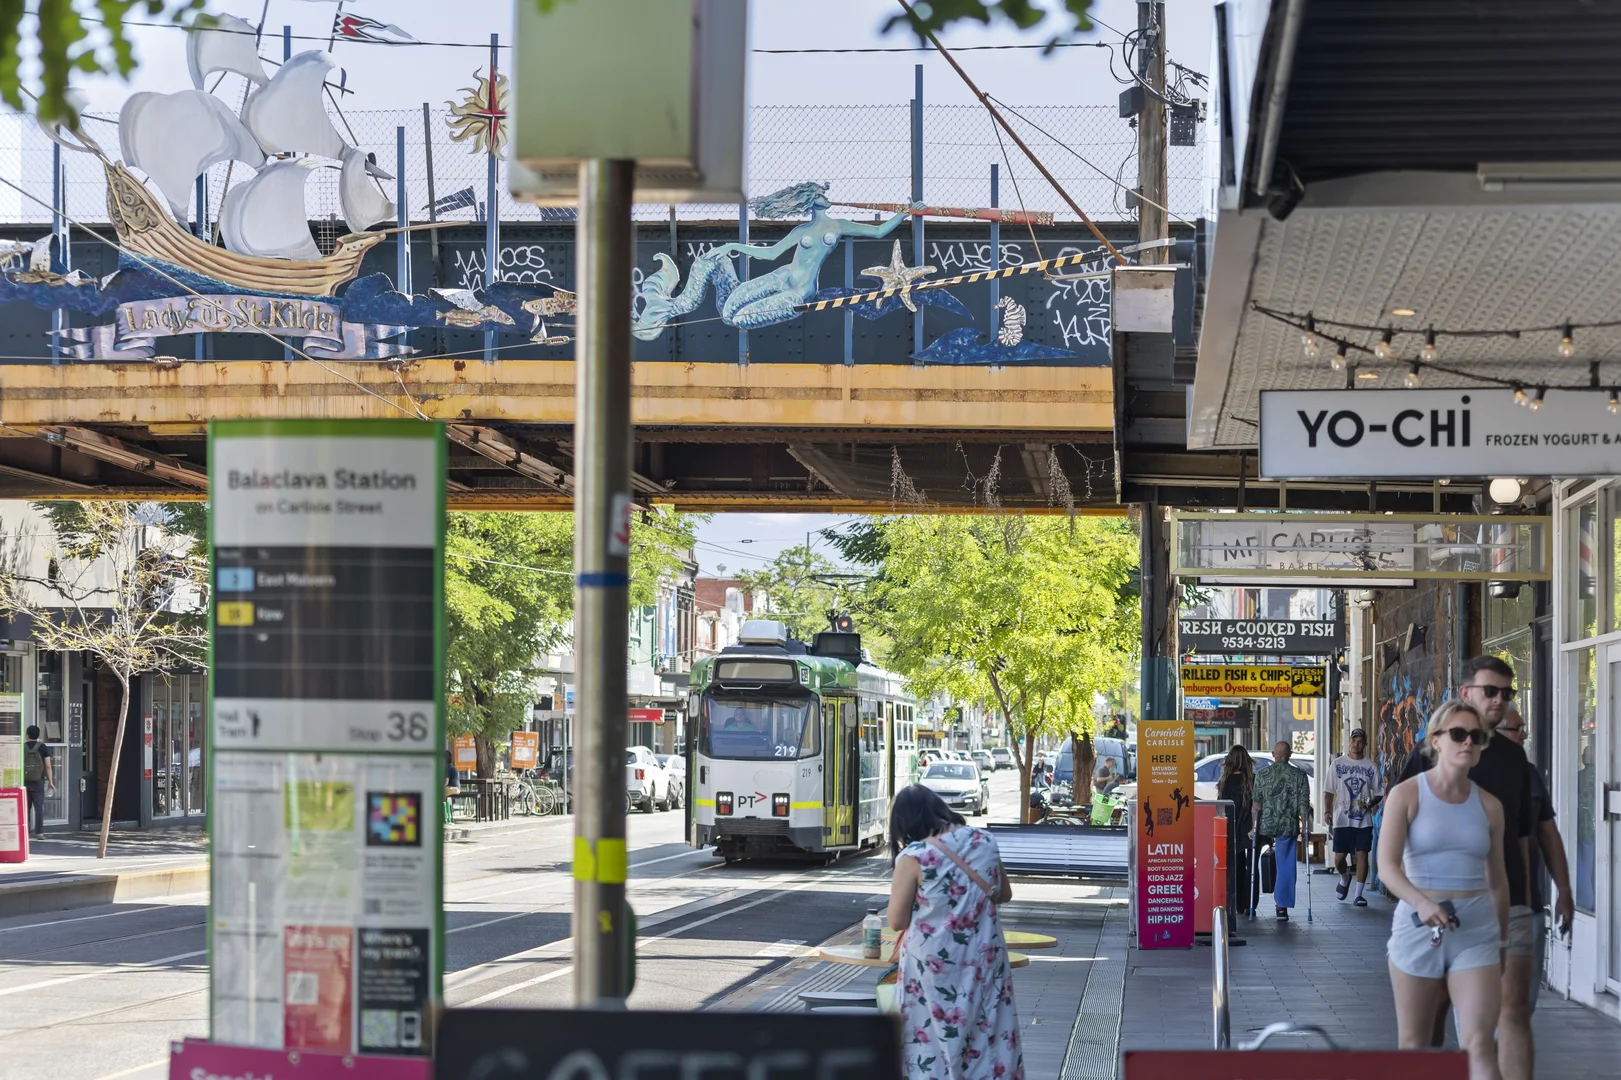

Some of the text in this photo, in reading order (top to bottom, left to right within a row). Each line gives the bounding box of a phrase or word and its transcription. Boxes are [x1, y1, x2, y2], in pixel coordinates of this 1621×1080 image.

[124, 303, 190, 334] Lady
[195, 297, 231, 329] of
[268, 300, 334, 332] Kilda
[1486, 433, 1538, 446] FROZEN
[1543, 433, 1599, 446] YOGURT
[1603, 434, 1611, 444] &
[228, 468, 416, 491] Balaclava Station
[256, 500, 383, 514] on Carlisle Street
[257, 608, 283, 621] Kew
[1180, 621, 1222, 635] RESH
[1301, 623, 1334, 637] FISH
[1224, 669, 1248, 681] FISH
[1250, 672, 1257, 681] &
[1259, 669, 1291, 681] CHIPS
[1224, 682, 1258, 694] Oysters
[1259, 683, 1291, 694] Crayfish
[1195, 709, 1236, 719] SOHO
[774, 745, 796, 757] 219
[1151, 754, 1177, 763] HERE
[802, 768, 811, 777] 219
[1147, 843, 1184, 856] LATIN
[1147, 874, 1164, 882] KIDS
[1148, 884, 1183, 894] GREEK
[1147, 915, 1184, 924] HIP HOP
